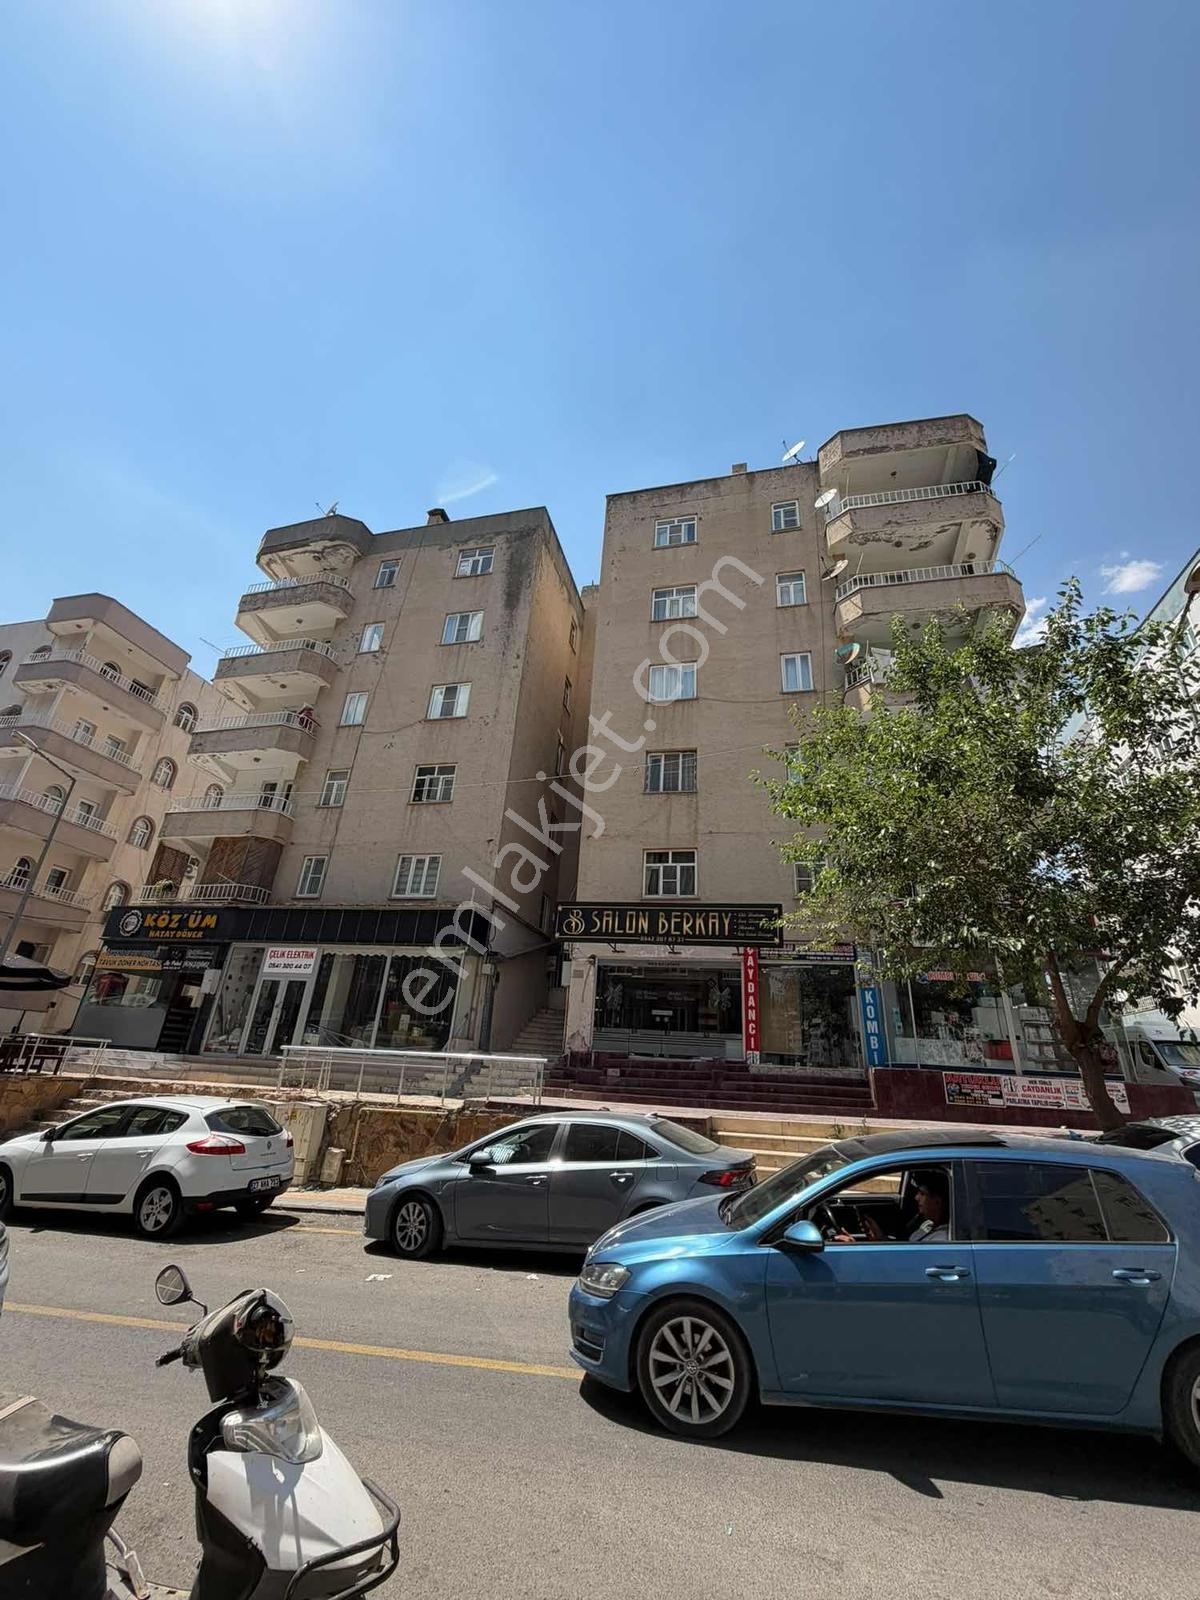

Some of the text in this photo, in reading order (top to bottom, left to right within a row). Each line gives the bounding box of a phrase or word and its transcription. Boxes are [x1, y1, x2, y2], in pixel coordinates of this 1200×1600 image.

[143, 910, 218, 928] KÖZ'ÜM
[590, 910, 732, 936] SALON BERKAY
